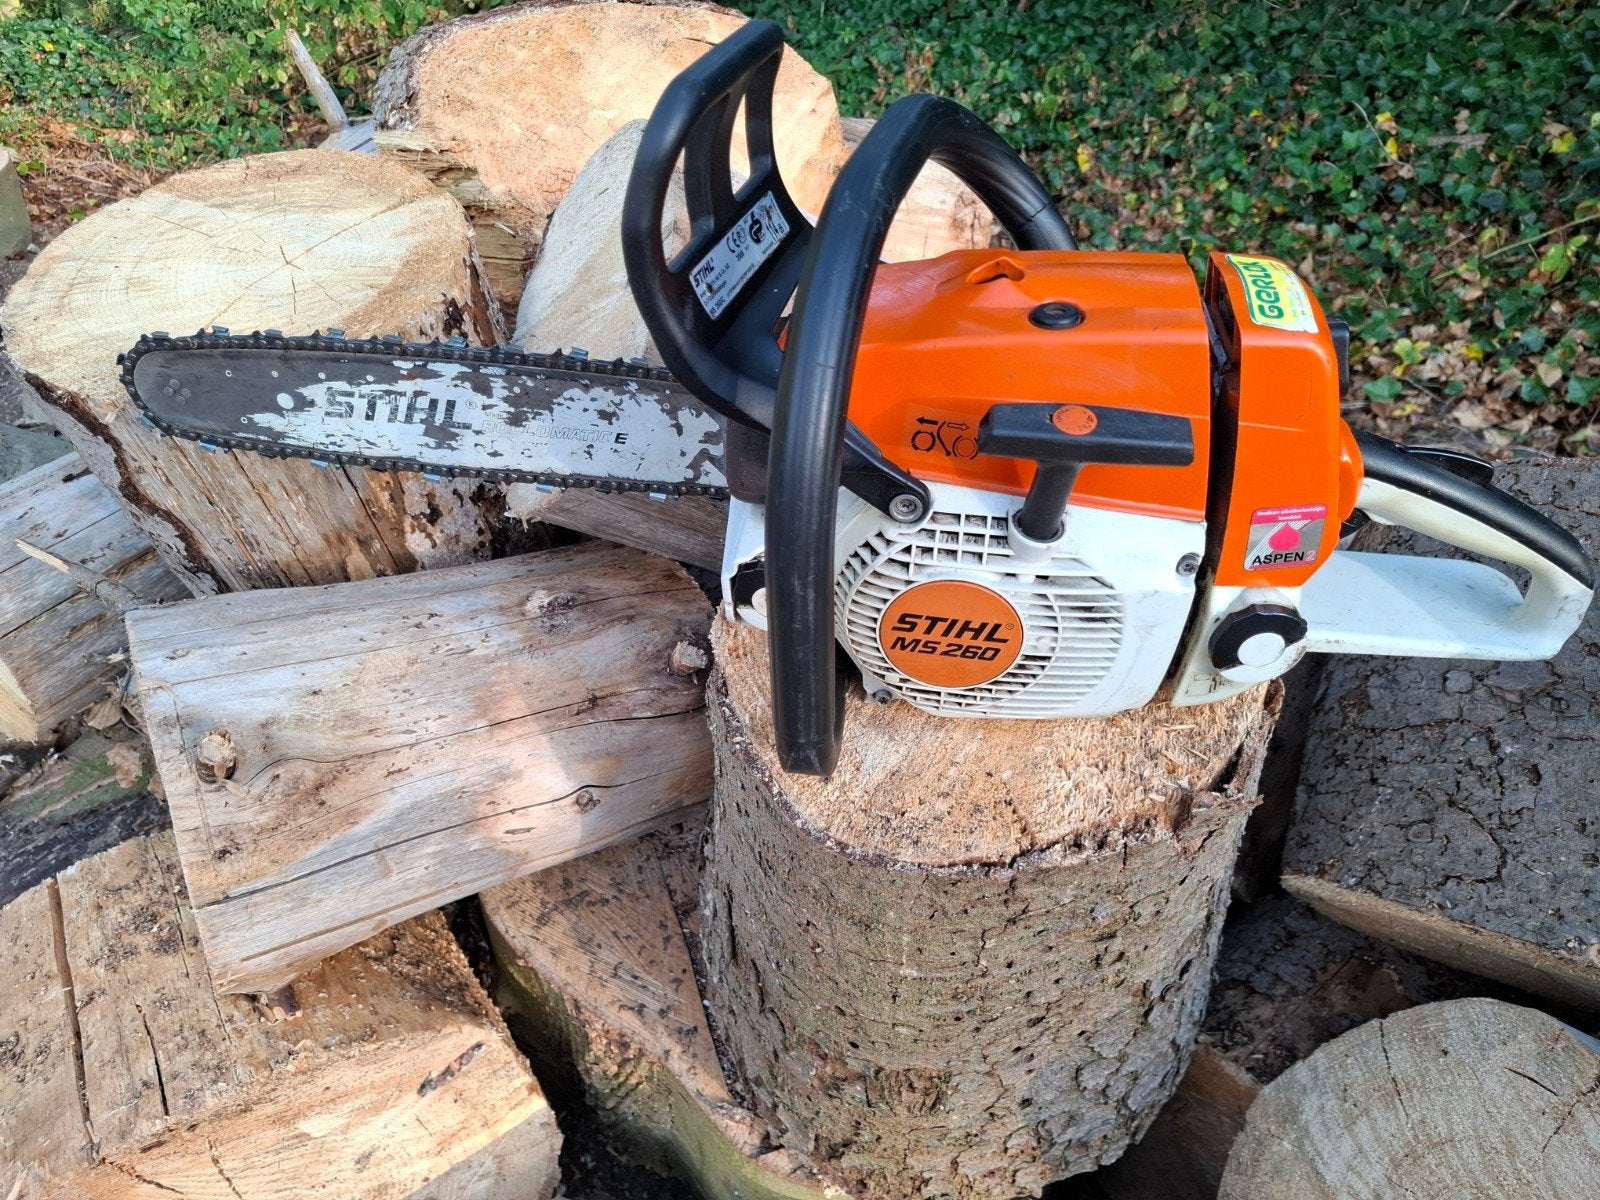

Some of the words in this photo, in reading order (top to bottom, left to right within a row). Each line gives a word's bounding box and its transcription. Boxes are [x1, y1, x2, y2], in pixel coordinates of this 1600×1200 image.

[692, 262, 715, 288] STIHL
[324, 386, 473, 430] STIHL
[613, 432, 629, 445] E
[1251, 551, 1304, 565] ASPEN
[1305, 550, 1317, 562] 2
[891, 613, 1009, 644] STIHL
[890, 636, 941, 654] MS
[939, 643, 1002, 661] 260
